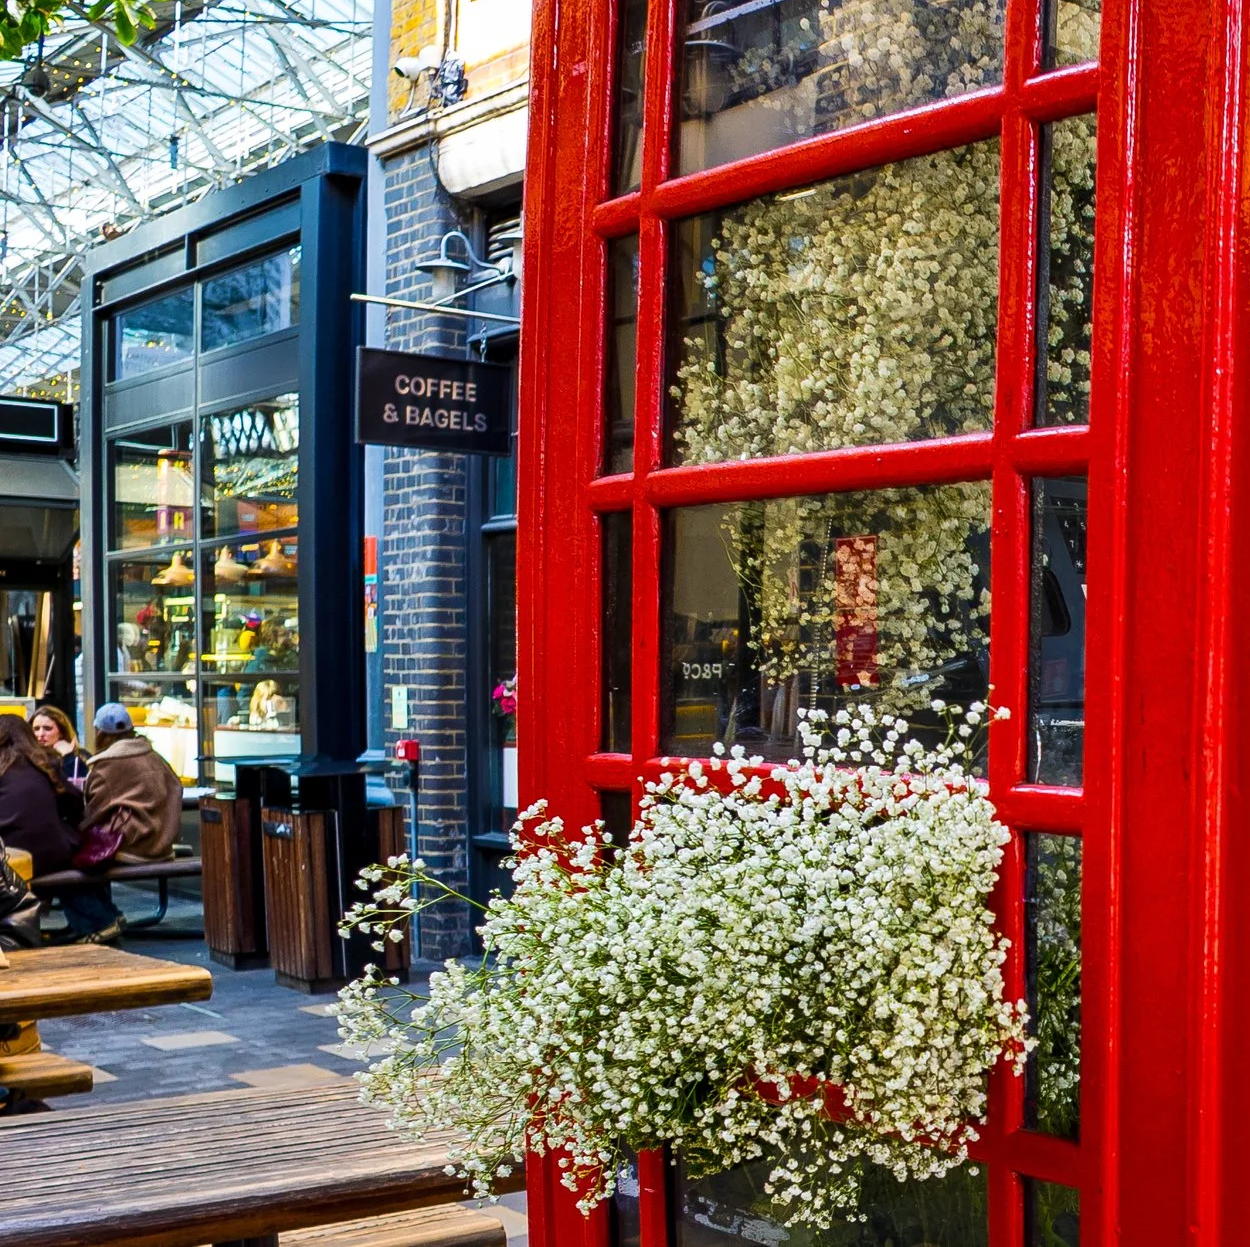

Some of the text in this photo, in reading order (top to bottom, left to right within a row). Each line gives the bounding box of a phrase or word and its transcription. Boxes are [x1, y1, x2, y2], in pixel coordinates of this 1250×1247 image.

[394, 374, 477, 403] COFFEE
[383, 403, 487, 433] & BAGELS
